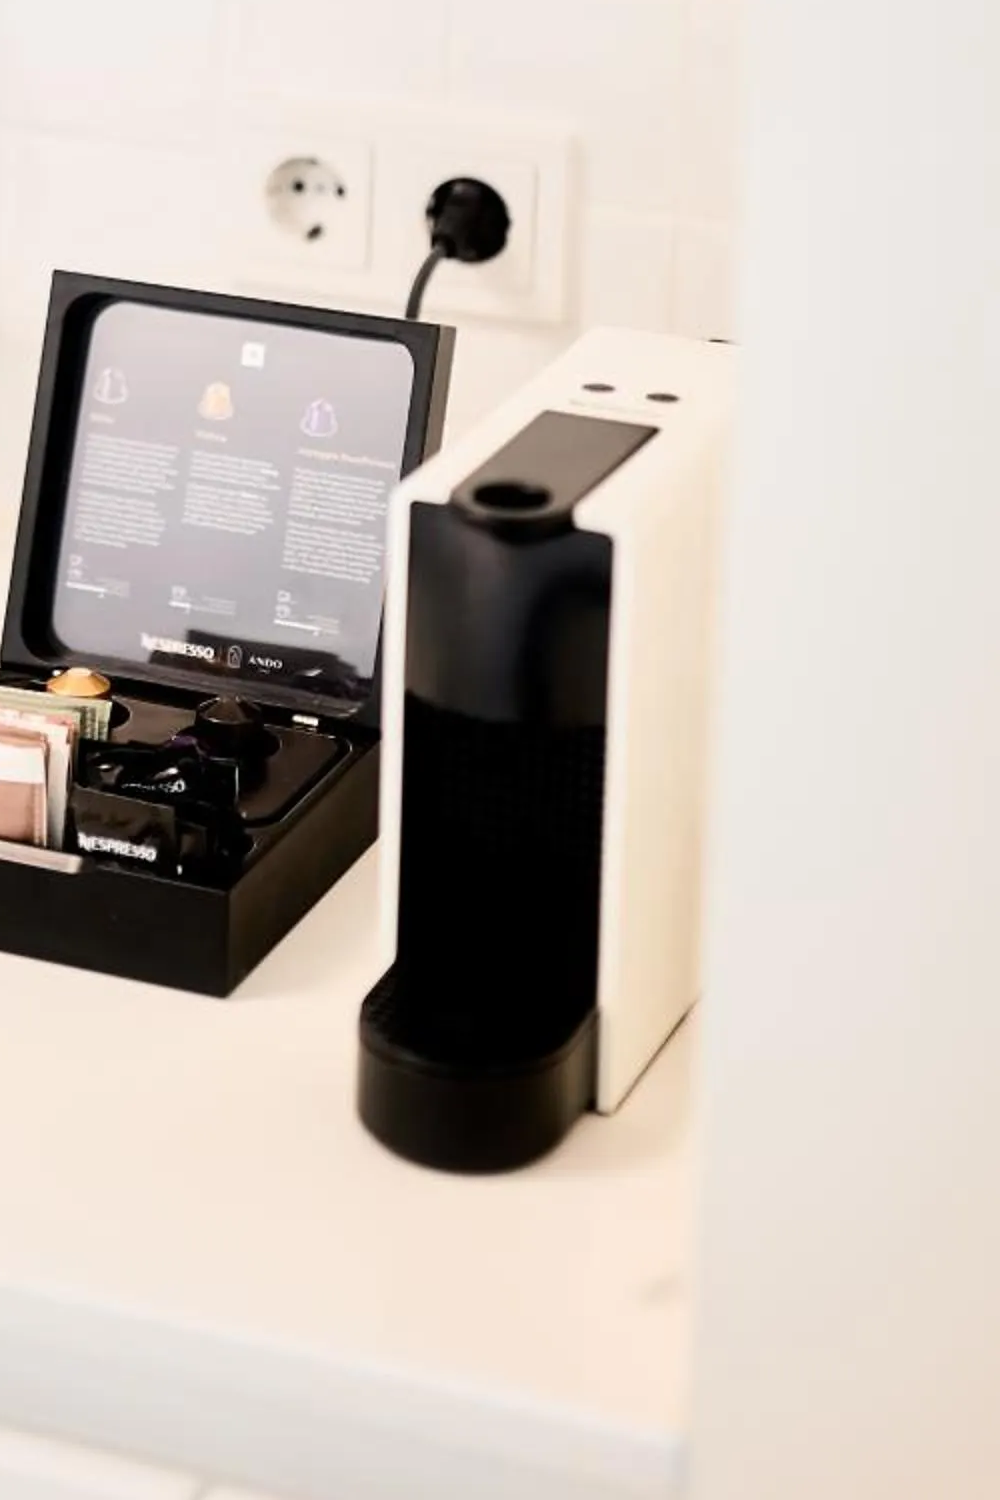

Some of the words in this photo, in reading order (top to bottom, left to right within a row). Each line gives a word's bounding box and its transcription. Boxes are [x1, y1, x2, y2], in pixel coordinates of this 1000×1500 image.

[141, 632, 214, 660] NESPRESSO
[248, 655, 284, 670] ANDO
[78, 831, 157, 862] NESPRESSO
